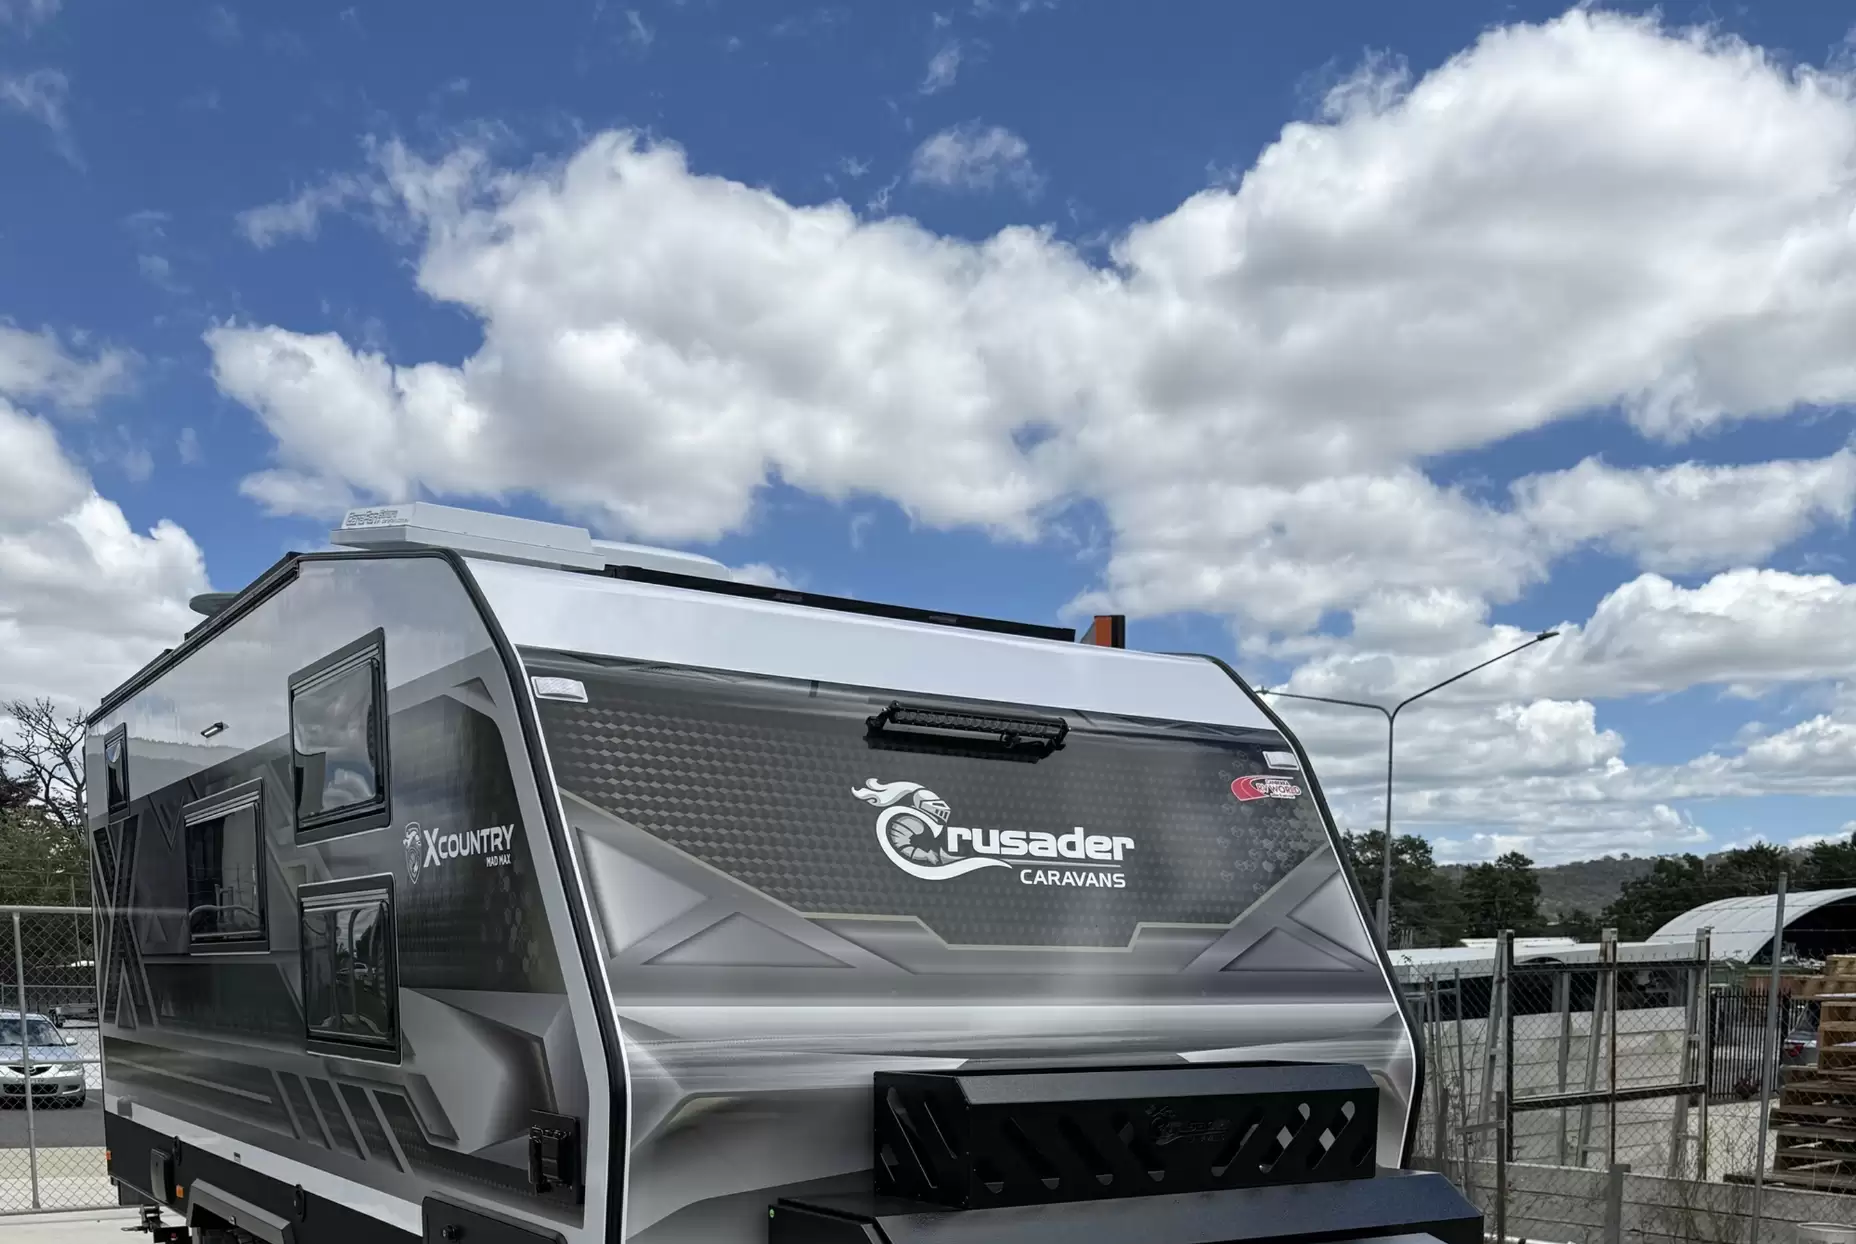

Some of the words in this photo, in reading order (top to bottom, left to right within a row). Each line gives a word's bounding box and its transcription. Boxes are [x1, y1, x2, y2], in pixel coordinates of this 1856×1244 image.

[1268, 784, 1301, 795] WORLD
[875, 805, 1135, 881] Crusader
[486, 855, 498, 868] MAD
[499, 853, 512, 865] MAX
[1020, 869, 1126, 888] CARAVANS
